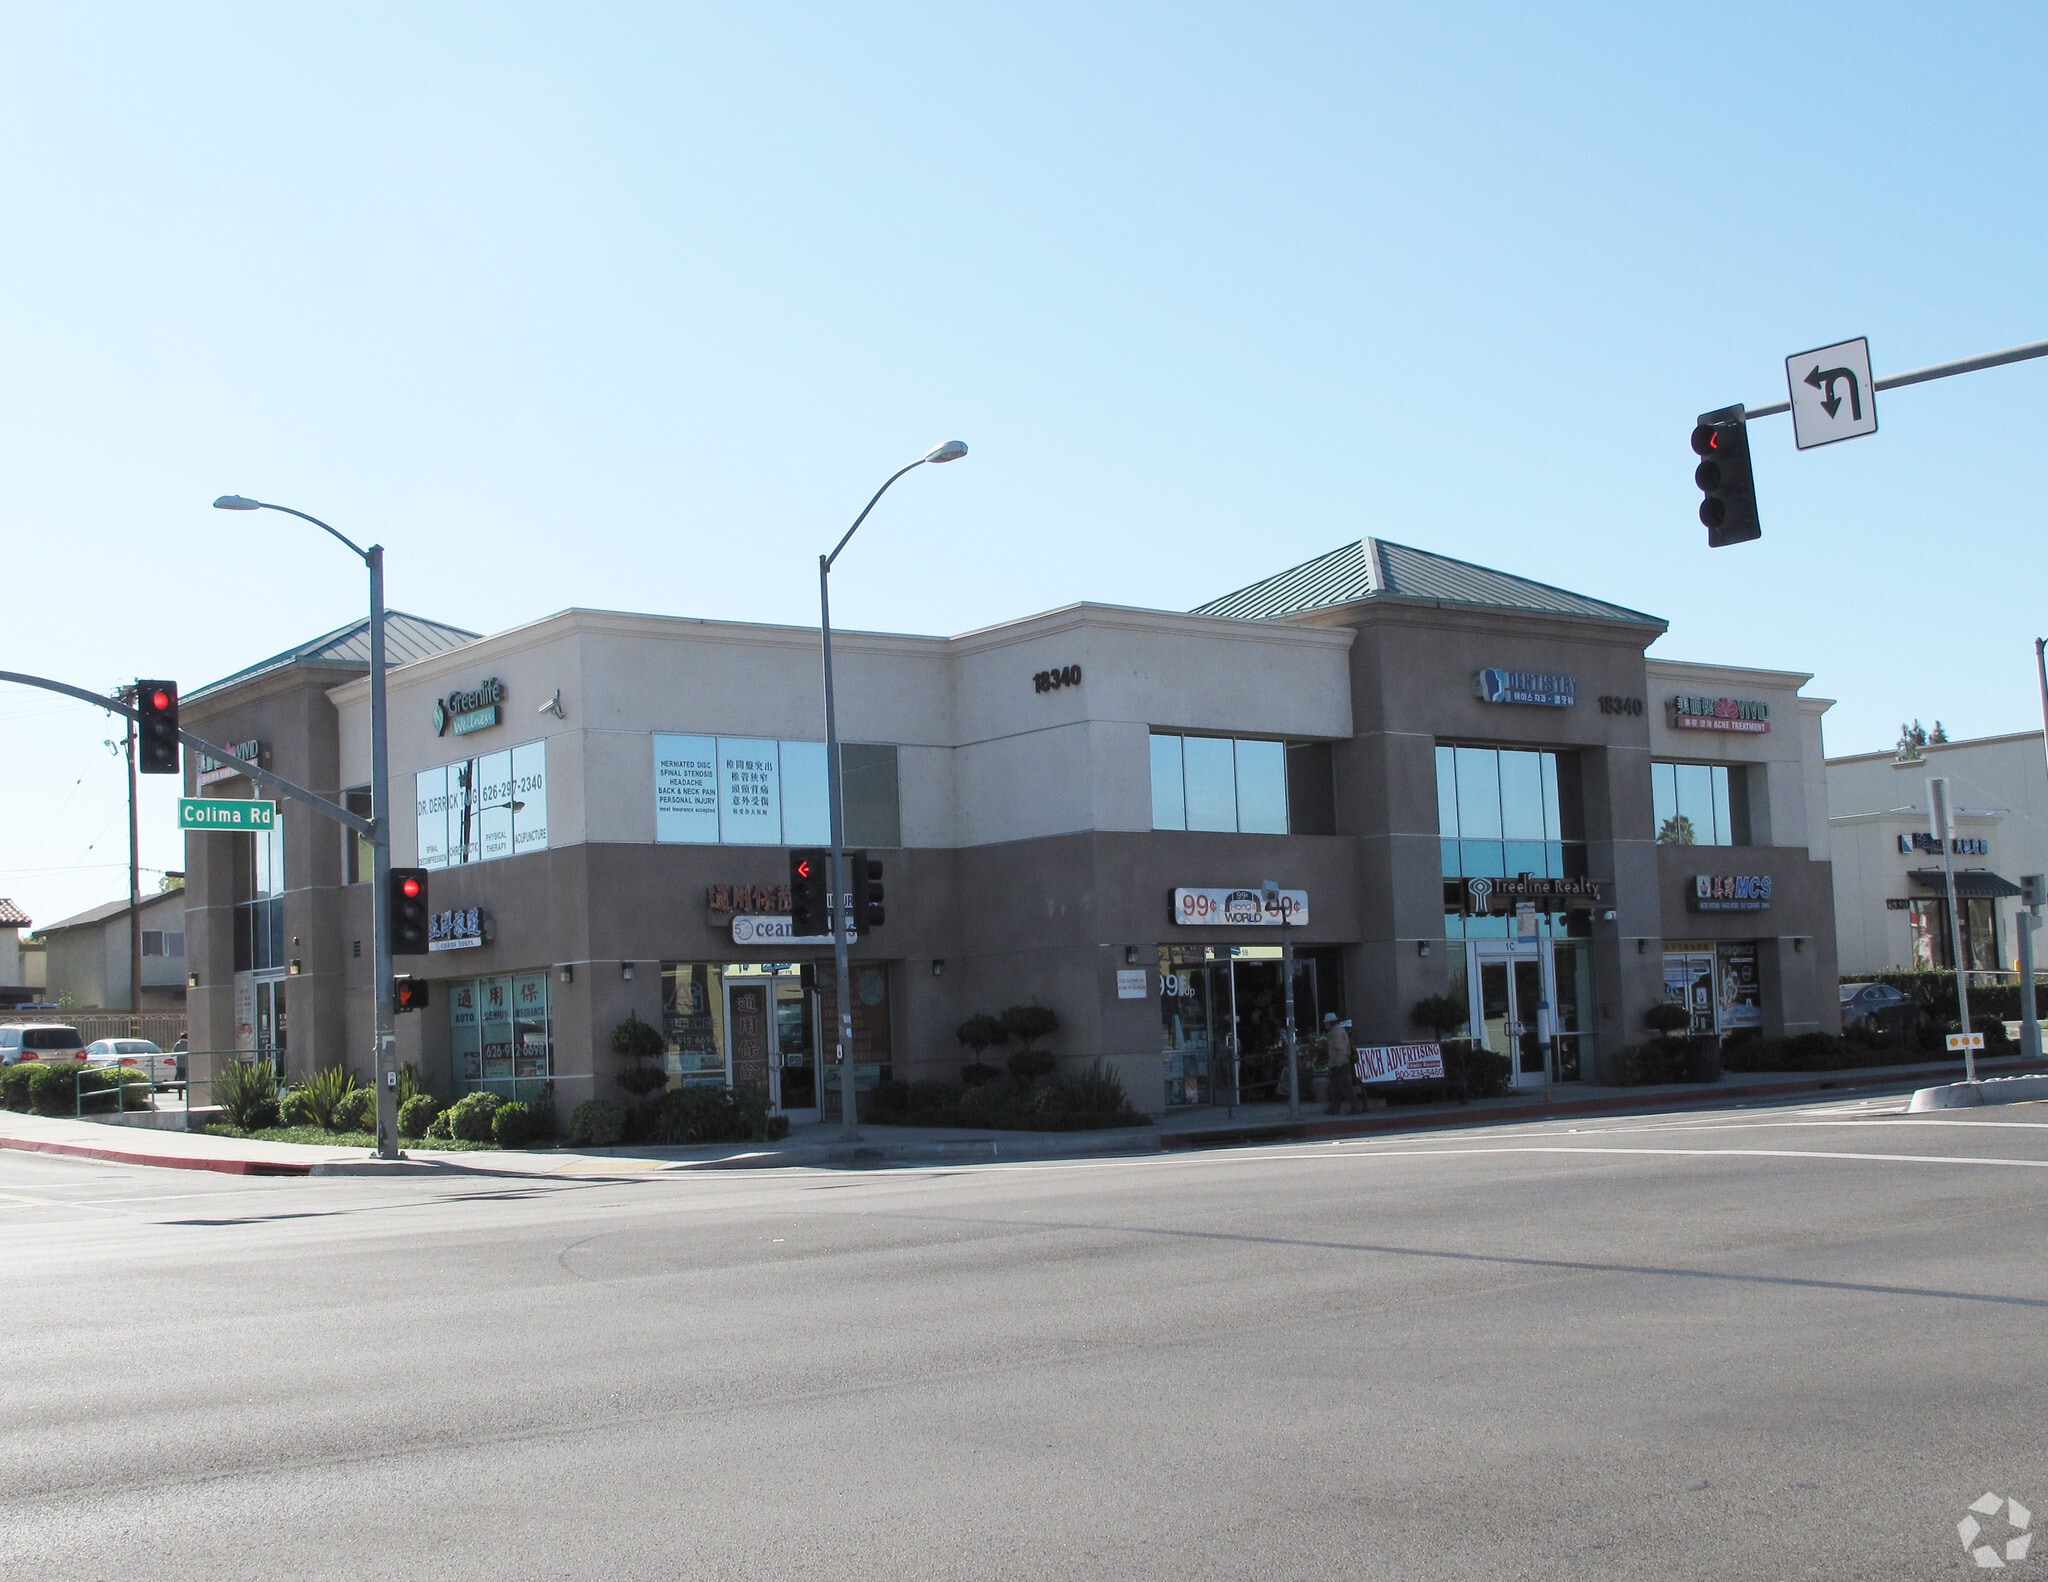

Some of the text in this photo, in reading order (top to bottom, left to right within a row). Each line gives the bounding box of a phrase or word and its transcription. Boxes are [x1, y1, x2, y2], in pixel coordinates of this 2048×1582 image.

[1033, 665, 1082, 693] 18340
[1508, 672, 1578, 693] DENTISTRY
[447, 677, 500, 716] Greenlife
[1598, 696, 1643, 716] 18340
[1738, 700, 1769, 720] VIVID
[1714, 720, 1730, 730] ACNE
[1731, 722, 1765, 731] TREATMENT
[661, 760, 695, 768] HERNIATED
[660, 769, 713, 778] SPINAL STENOSIS
[418, 800, 429, 816] DR.
[429, 791, 459, 815] DERRICK
[482, 774, 543, 802] 626-297-2340
[660, 796, 715, 805] PERSONAL INJURY
[702, 788, 716, 796] PAIN
[184, 805, 271, 824] Colima Rd
[485, 830, 507, 841] PHYSICAL
[515, 828, 547, 844] ACUPUNCTURE
[486, 842, 507, 853] THERAPY
[1495, 873, 1599, 896] Treeline Realty
[1735, 876, 1772, 899] MCS
[1182, 894, 1217, 917] 99¢
[1224, 912, 1262, 923] WORLD
[1506, 943, 1515, 951] 1C
[455, 1013, 475, 1024] AUTO
[1386, 1043, 1439, 1073] ADVERTISING
